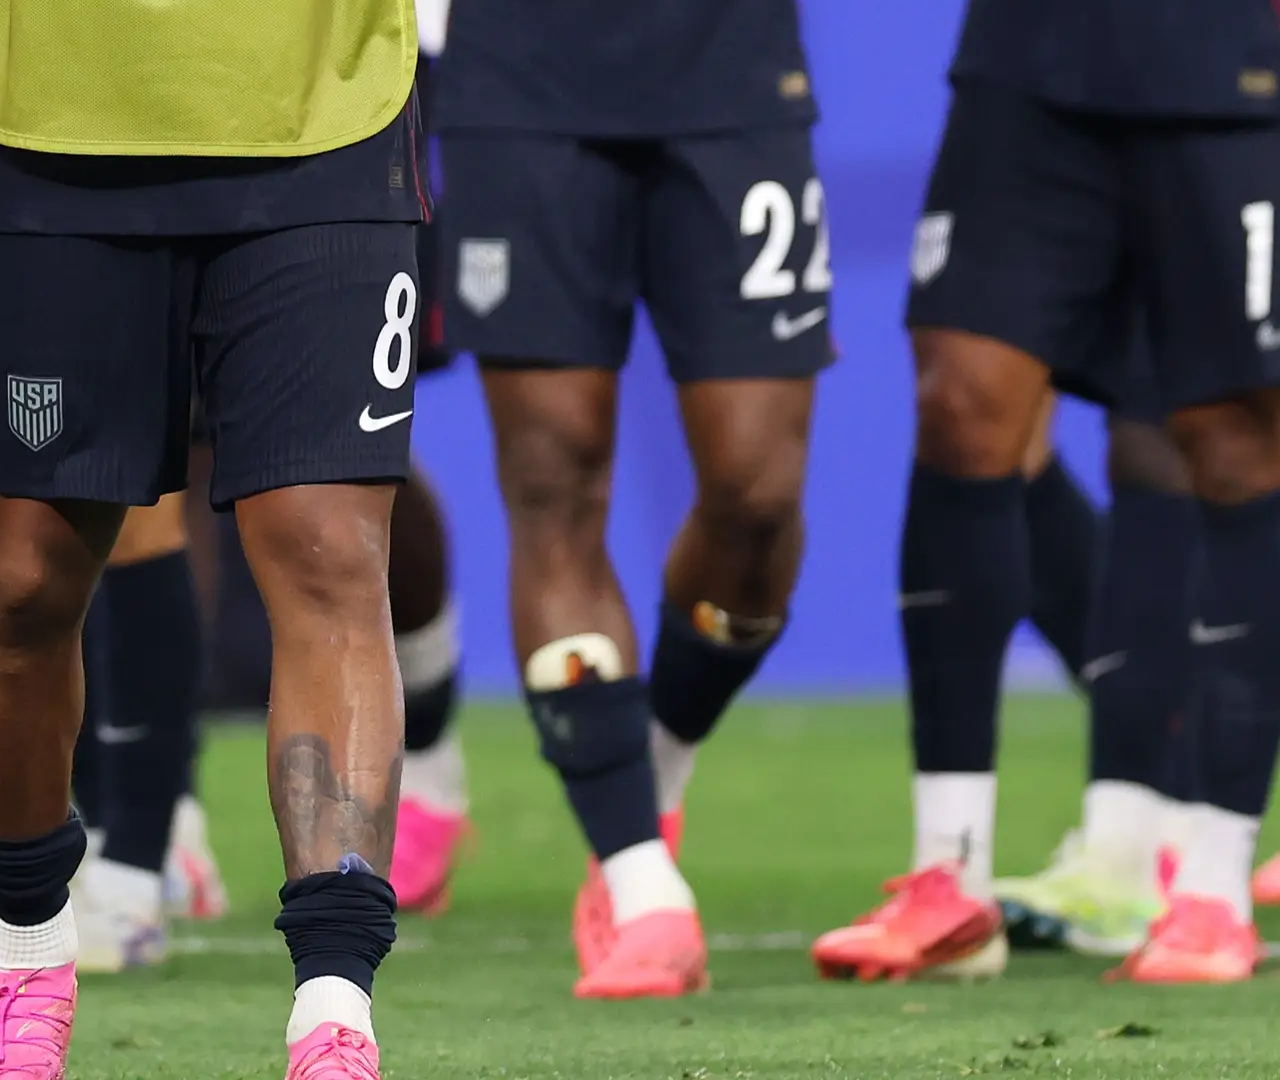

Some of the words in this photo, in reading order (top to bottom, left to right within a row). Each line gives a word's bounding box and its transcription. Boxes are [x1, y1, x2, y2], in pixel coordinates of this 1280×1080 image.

[739, 177, 834, 300] 22
[372, 271, 417, 390] 8
[11, 380, 58, 410] USA
